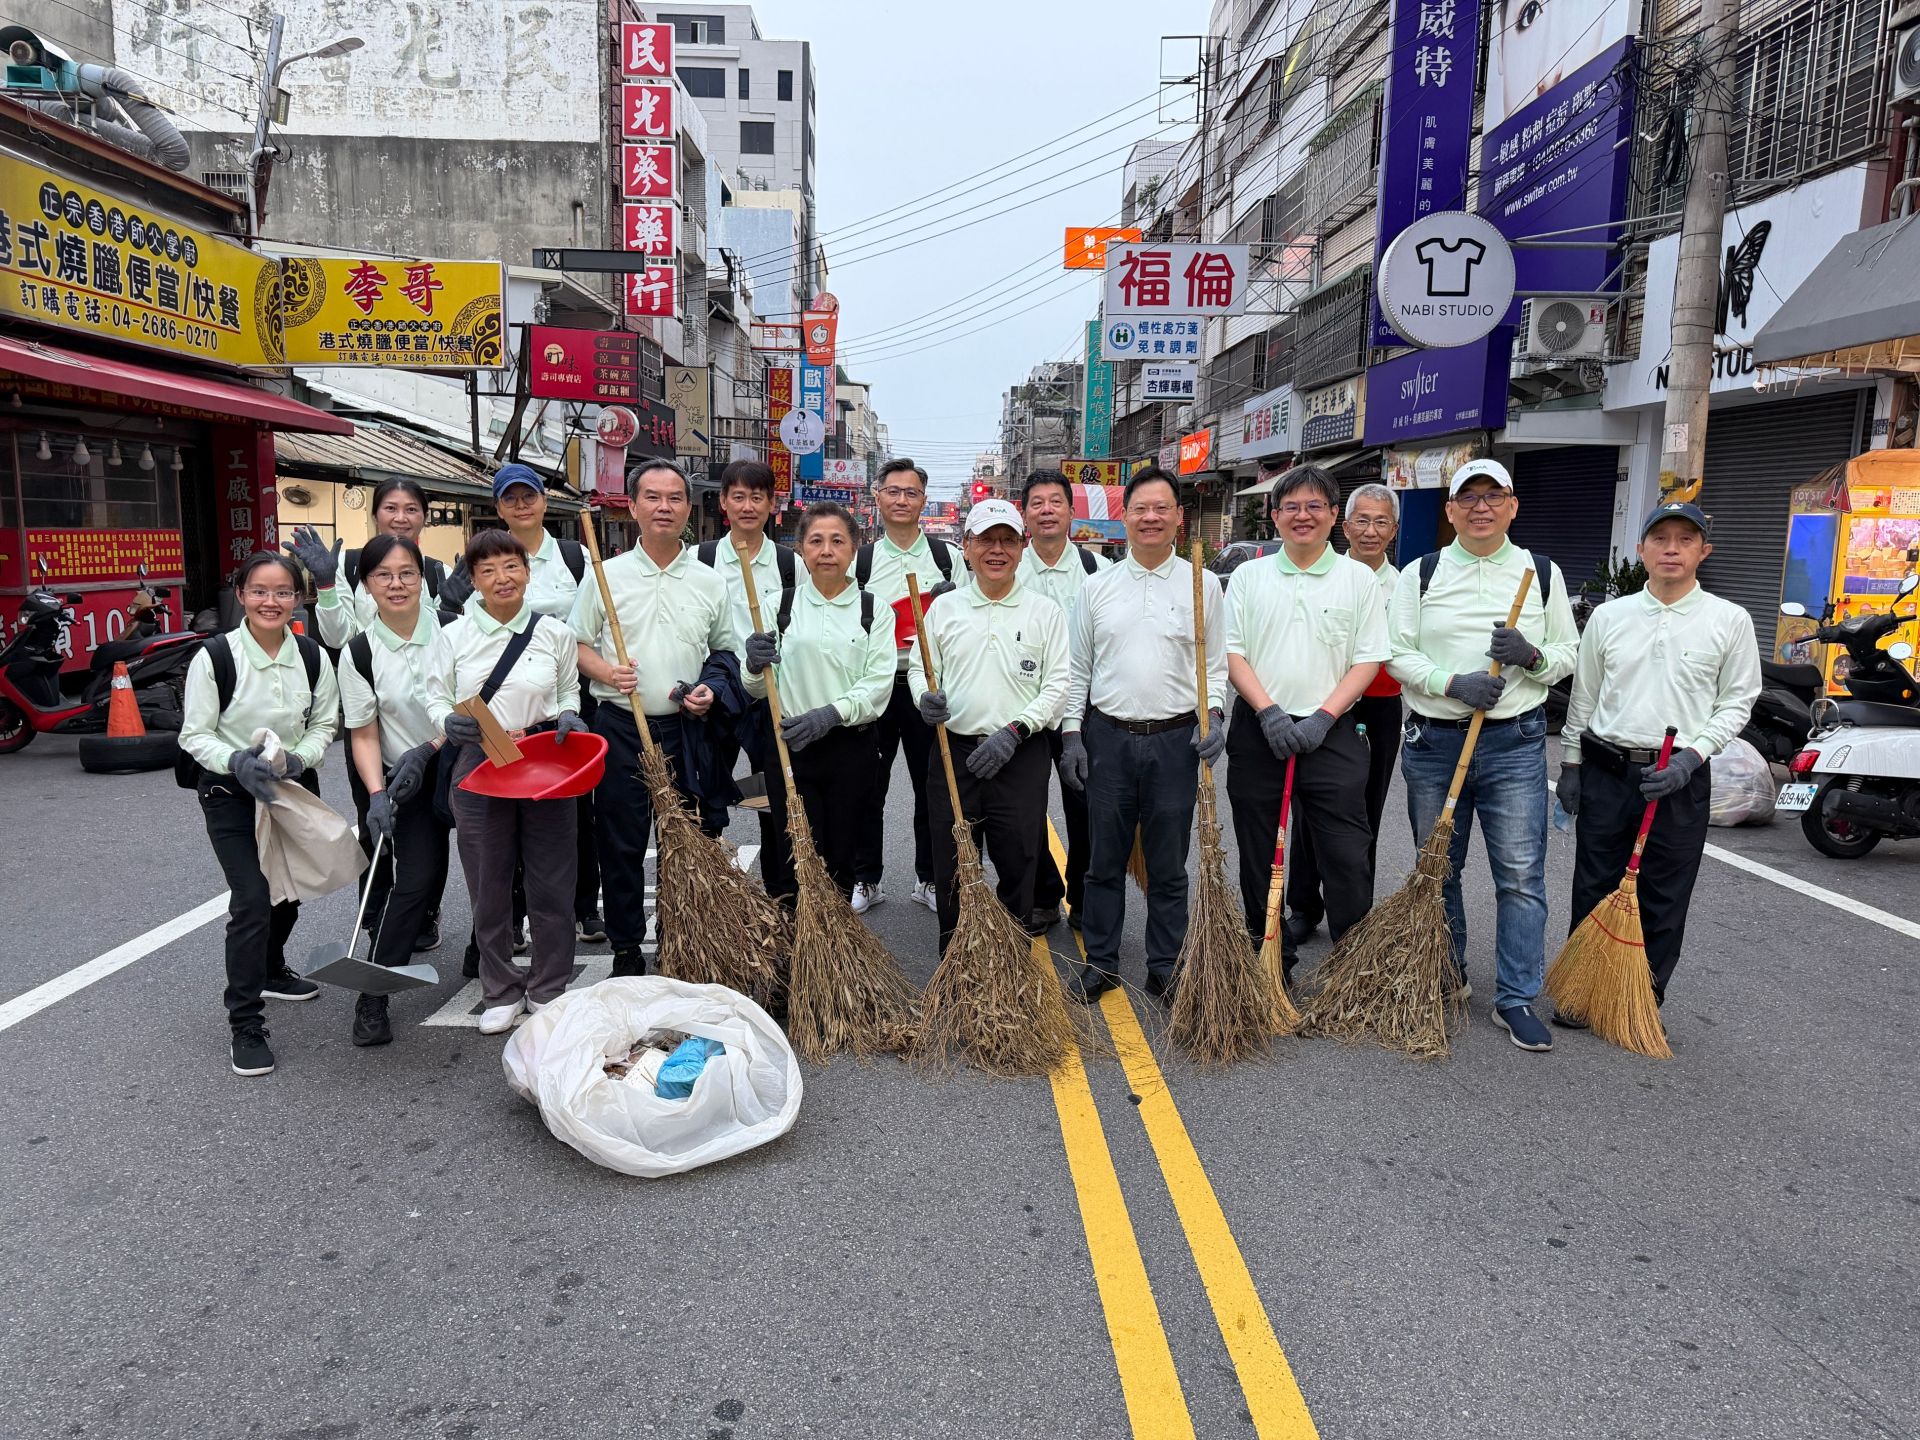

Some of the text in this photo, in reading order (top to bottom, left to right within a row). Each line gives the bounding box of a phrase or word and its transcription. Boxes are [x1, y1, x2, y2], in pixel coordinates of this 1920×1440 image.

[629, 27, 669, 312] 民光蔘藥行
[1418, 115, 1438, 212] 肌膚美麗的
[40, 183, 198, 268] 正宗香港師父掌廚
[344, 260, 444, 316] 李哥
[1118, 250, 1235, 307] 福倫
[1138, 321, 1199, 336] 慢性處方箋
[1401, 304, 1494, 317] NABI STUDIO
[1138, 340, 1198, 354] 免費調劑
[1147, 380, 1193, 394] 杏輝專櫃
